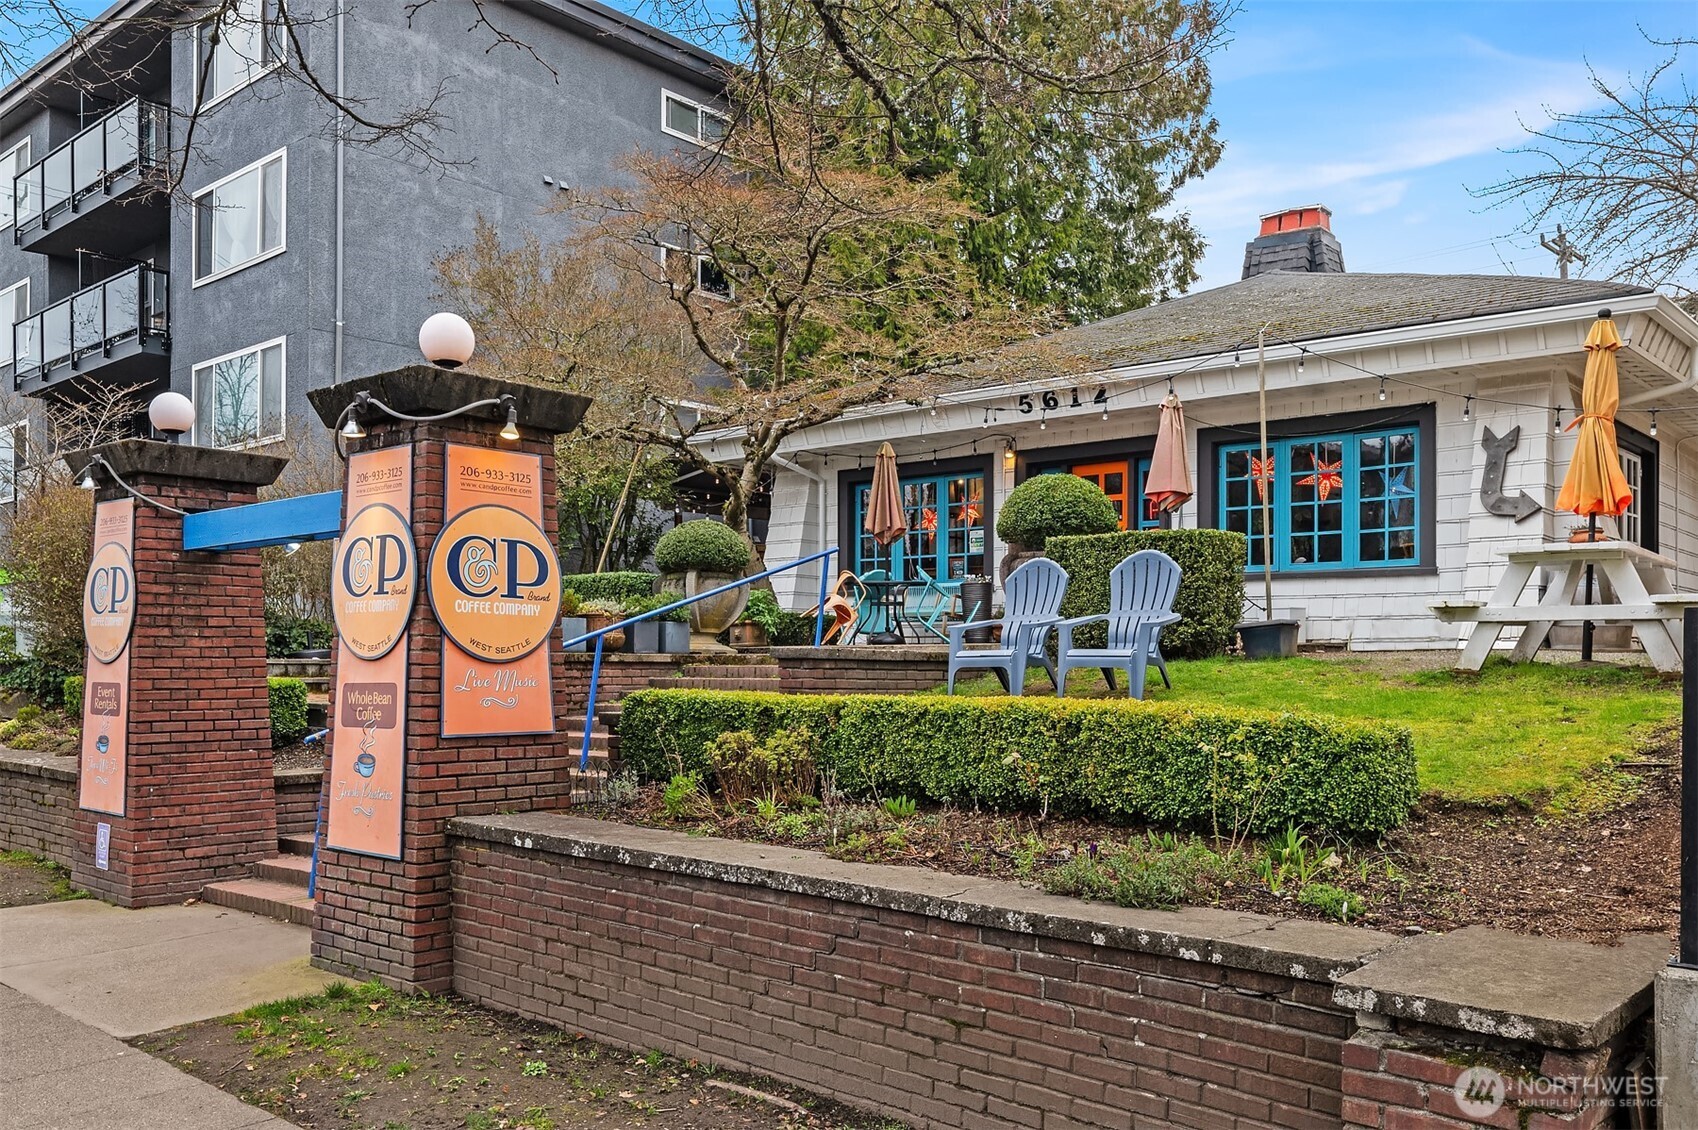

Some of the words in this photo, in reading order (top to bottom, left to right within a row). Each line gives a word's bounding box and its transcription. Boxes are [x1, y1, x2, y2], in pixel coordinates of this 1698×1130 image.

[356, 466, 403, 484] 206-933-3125
[460, 465, 532, 484] 206-933-3125
[527, 591, 551, 602] Brand
[345, 600, 367, 614] COFFEE
[368, 598, 400, 613] COMPANY
[455, 599, 492, 614] COFFEE
[493, 601, 541, 617] COMPANY
[351, 636, 366, 651] WEST
[367, 634, 393, 653] SEATTLE
[469, 637, 492, 653] WEST
[495, 638, 532, 655] SEATTLE
[454, 668, 491, 692] Live
[493, 669, 539, 692] Music
[97, 686, 116, 698] Event
[347, 690, 373, 705] Whole
[373, 692, 392, 705] Bean
[94, 698, 118, 710] Rentals
[356, 706, 382, 721] Coffee
